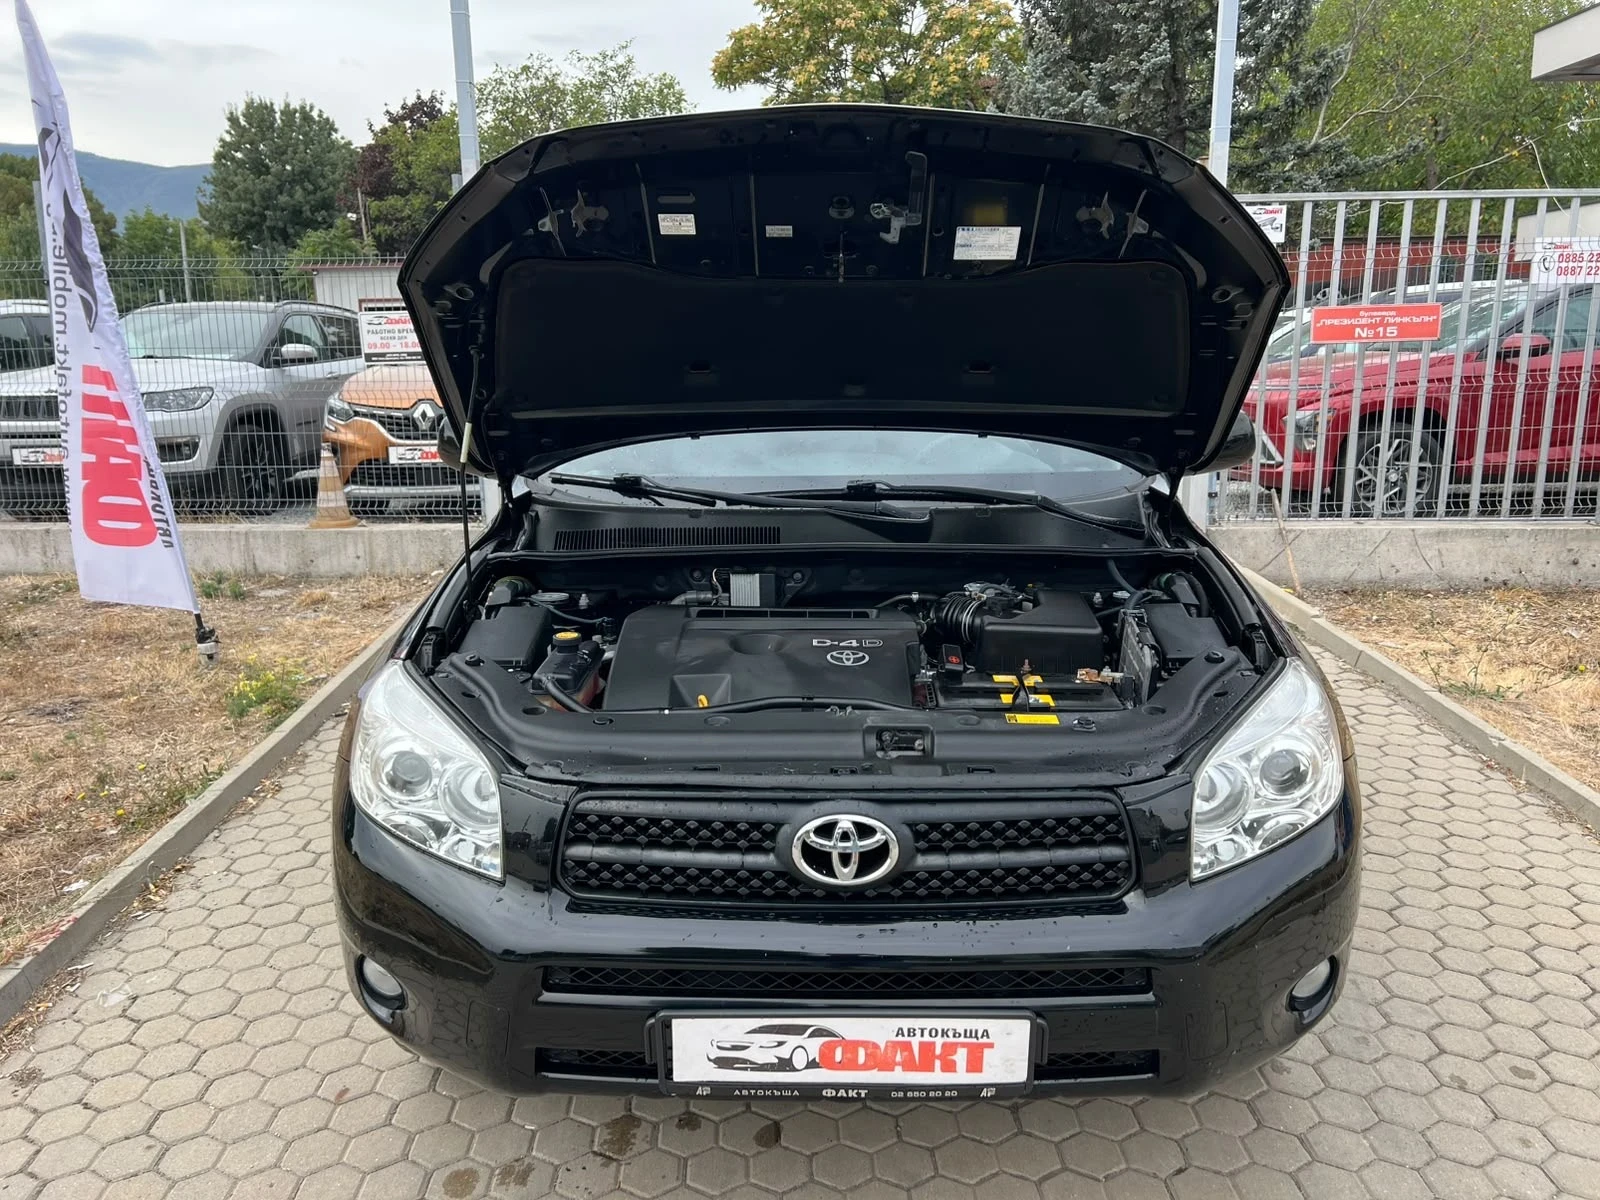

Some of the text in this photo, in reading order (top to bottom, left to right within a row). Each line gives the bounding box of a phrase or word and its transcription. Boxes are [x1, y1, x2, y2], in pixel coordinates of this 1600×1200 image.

[1557, 252, 1585, 263] 0885
[1556, 265, 1600, 276] 0887 22
[367, 342, 390, 350] 09.00
[895, 1027, 991, 1041] АВТОКЪЩА
[818, 1039, 995, 1074] ФАКТ
[822, 1088, 869, 1098] ФАКТ
